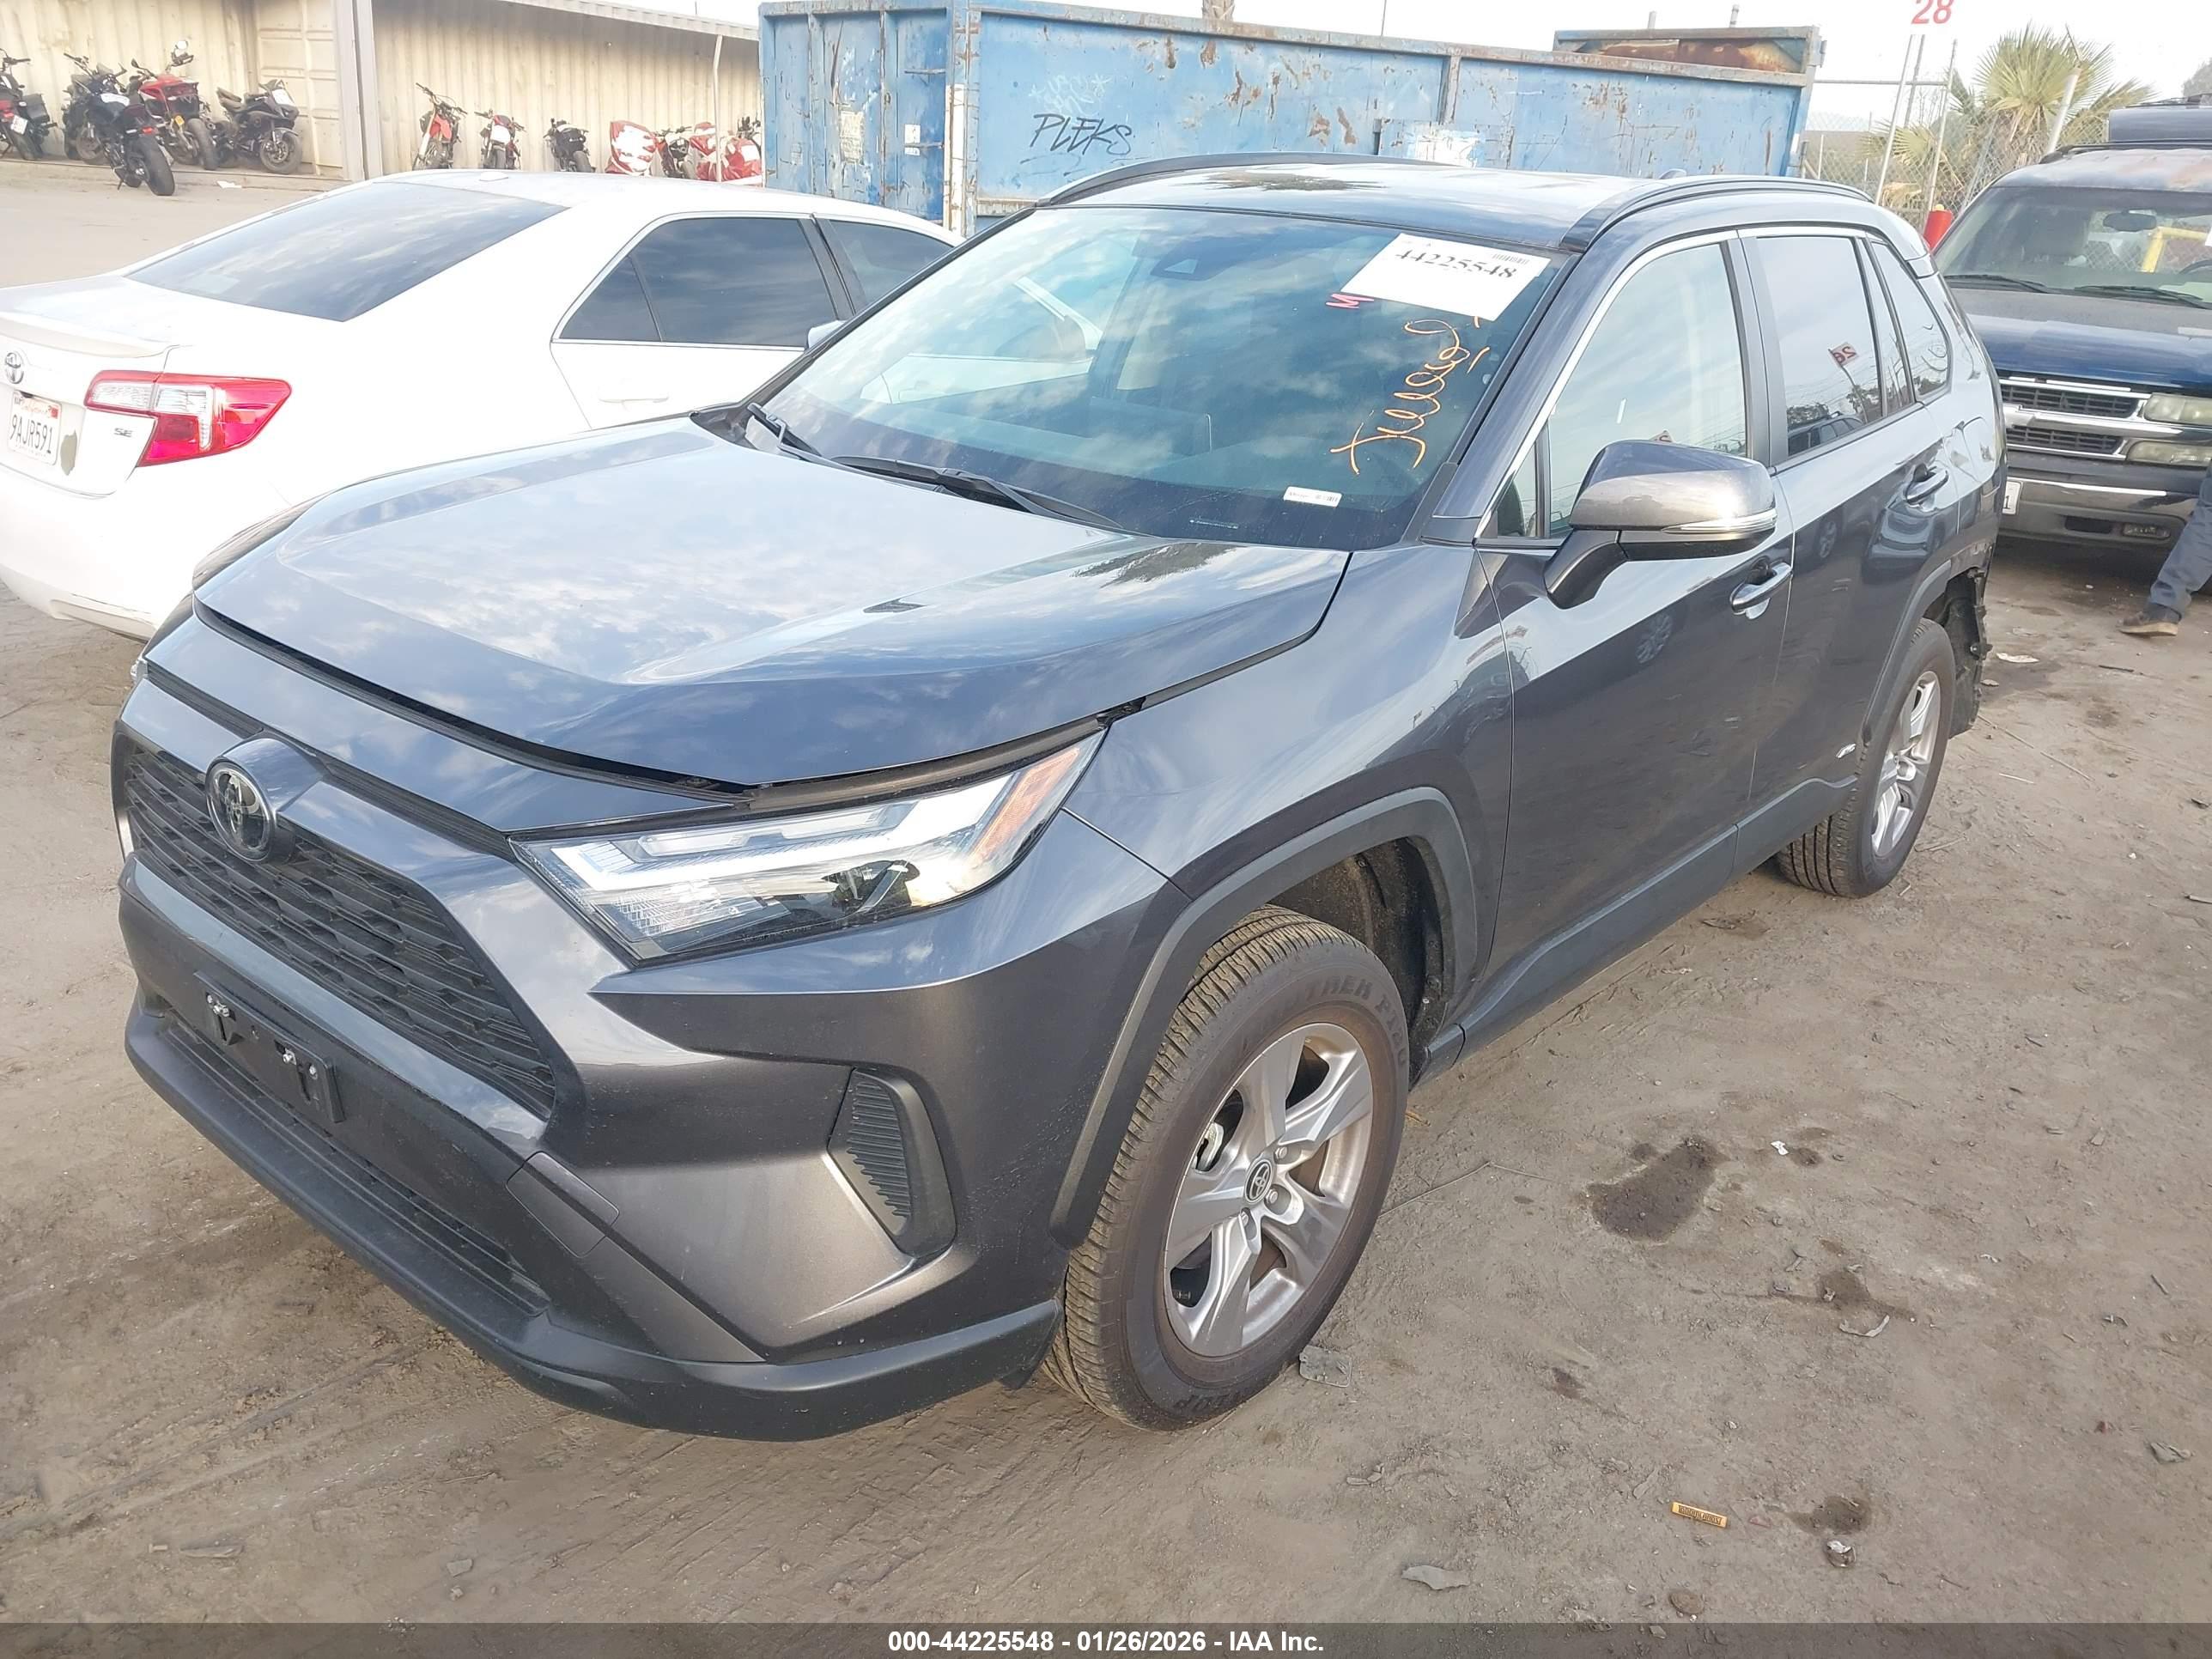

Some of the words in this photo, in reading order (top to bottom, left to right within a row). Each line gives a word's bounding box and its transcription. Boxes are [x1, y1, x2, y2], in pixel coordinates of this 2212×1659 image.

[1911, 0, 1954, 24] 28
[1395, 249, 1517, 278] 44225548
[9, 414, 53, 455] 9AJR591
